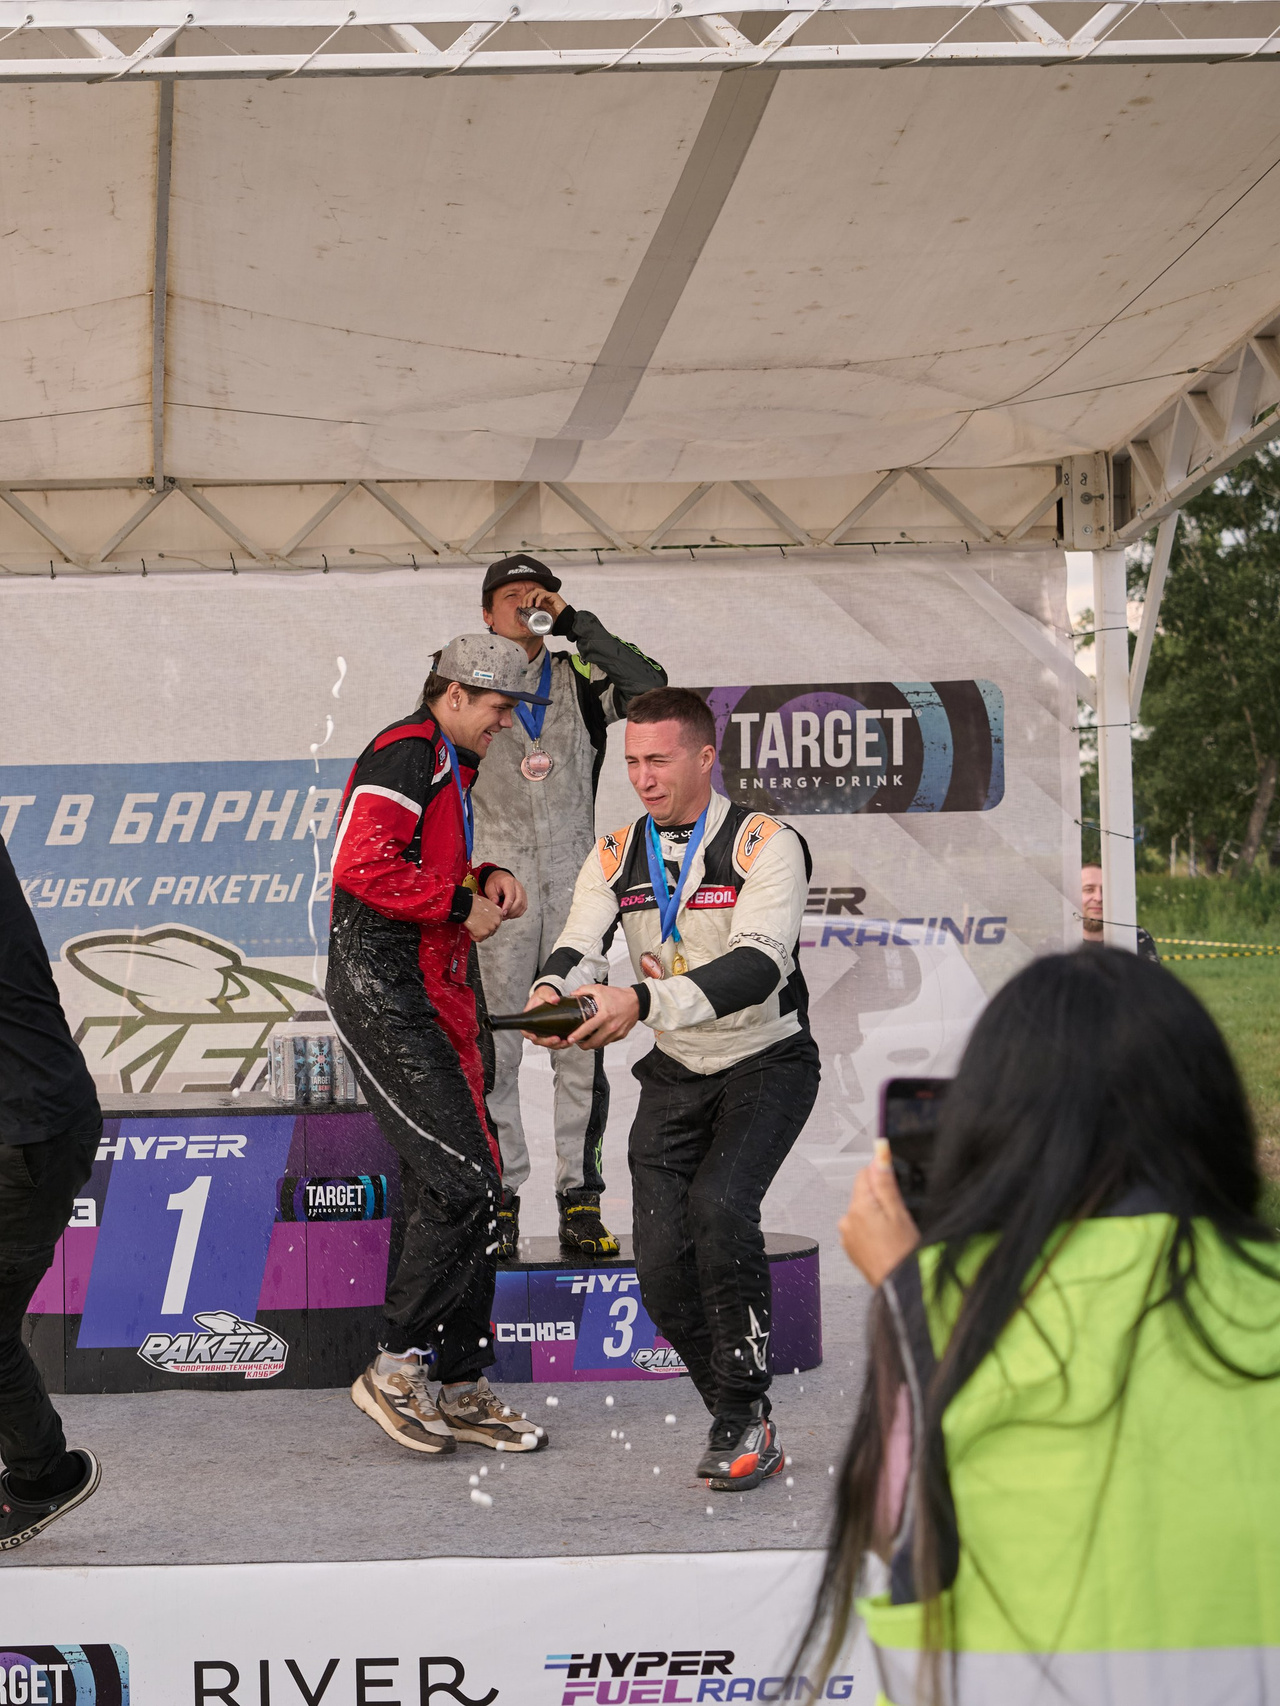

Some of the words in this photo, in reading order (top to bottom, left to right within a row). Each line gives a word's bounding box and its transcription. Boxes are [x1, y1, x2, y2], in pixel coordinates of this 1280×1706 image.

[731, 709, 912, 769] TARGET
[740, 776, 822, 789] ENERGY
[836, 775, 903, 788] DRINK
[44, 794, 95, 846] В
[109, 788, 344, 844] БАРНА
[21, 877, 143, 908] КУБОК
[147, 873, 304, 905] РАКЕТЫ
[313, 872, 332, 902] 2
[620, 893, 646, 907] RDS
[799, 916, 1008, 948] RACING
[95, 1134, 248, 1161] HYPER
[306, 1184, 365, 1207] TARGET
[160, 1175, 212, 1315] 1
[570, 1273, 640, 1294] HYP
[496, 1321, 576, 1342] СОЮЗ
[603, 1296, 638, 1358] 3
[141, 1334, 285, 1363] РАКЕТА
[180, 1362, 284, 1372] СПОРТИВНО-ТЕХНИЧЕСКИЙ
[567, 1650, 736, 1679] HYPER
[194, 1656, 500, 1706] RIVER
